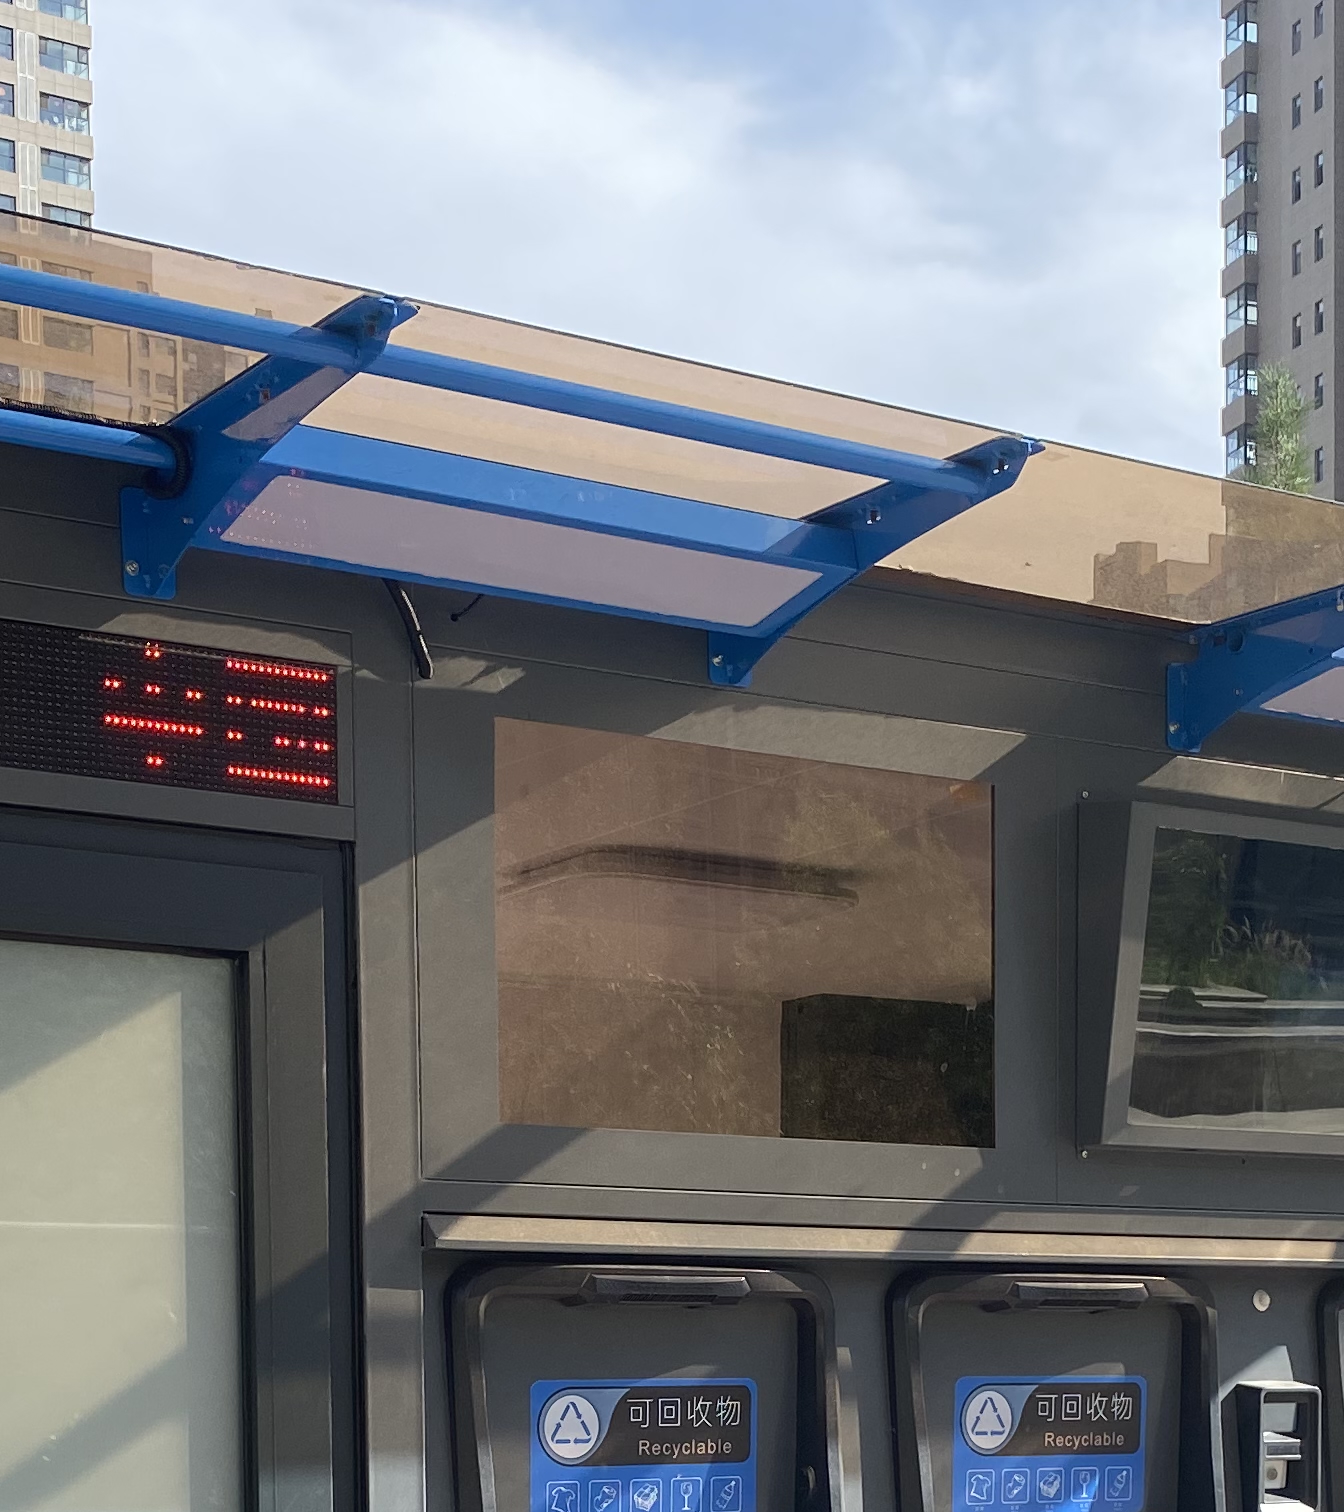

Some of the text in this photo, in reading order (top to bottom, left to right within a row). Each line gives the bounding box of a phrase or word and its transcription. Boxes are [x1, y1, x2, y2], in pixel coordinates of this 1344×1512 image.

[626, 1395, 741, 1428] 可回收物
[1035, 1391, 1133, 1422] 可回收物
[638, 1438, 732, 1459] Recyclable
[1044, 1431, 1125, 1451] Recyclable
